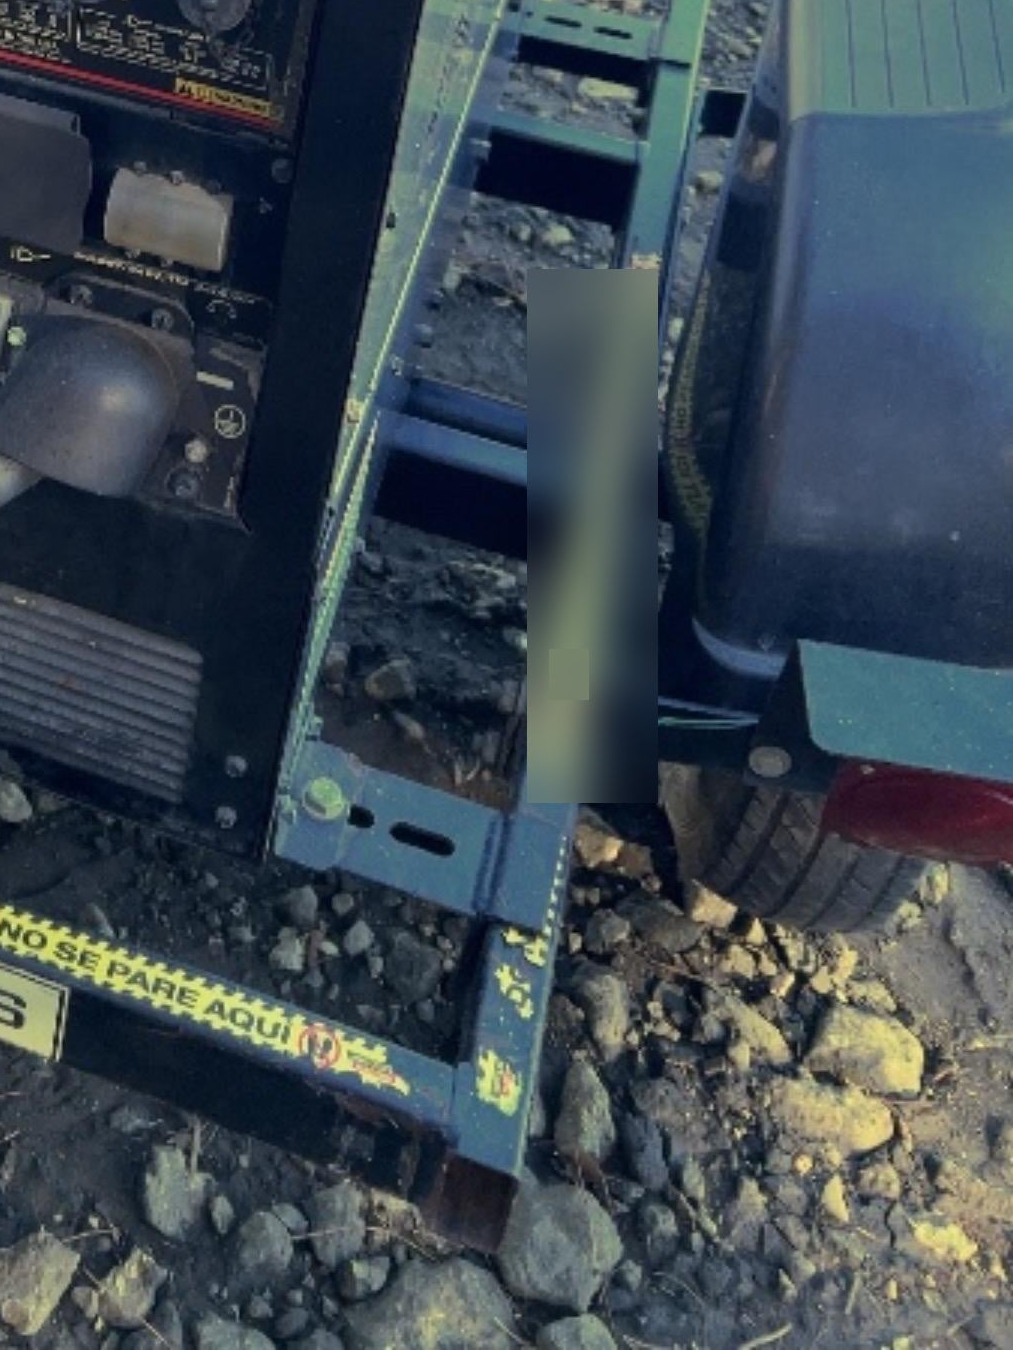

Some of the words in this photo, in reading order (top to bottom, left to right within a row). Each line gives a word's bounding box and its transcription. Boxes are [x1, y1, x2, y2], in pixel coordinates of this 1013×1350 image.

[53, 941, 101, 973] SE
[106, 959, 200, 1009] PARE
[203, 998, 291, 1045] AQUI
